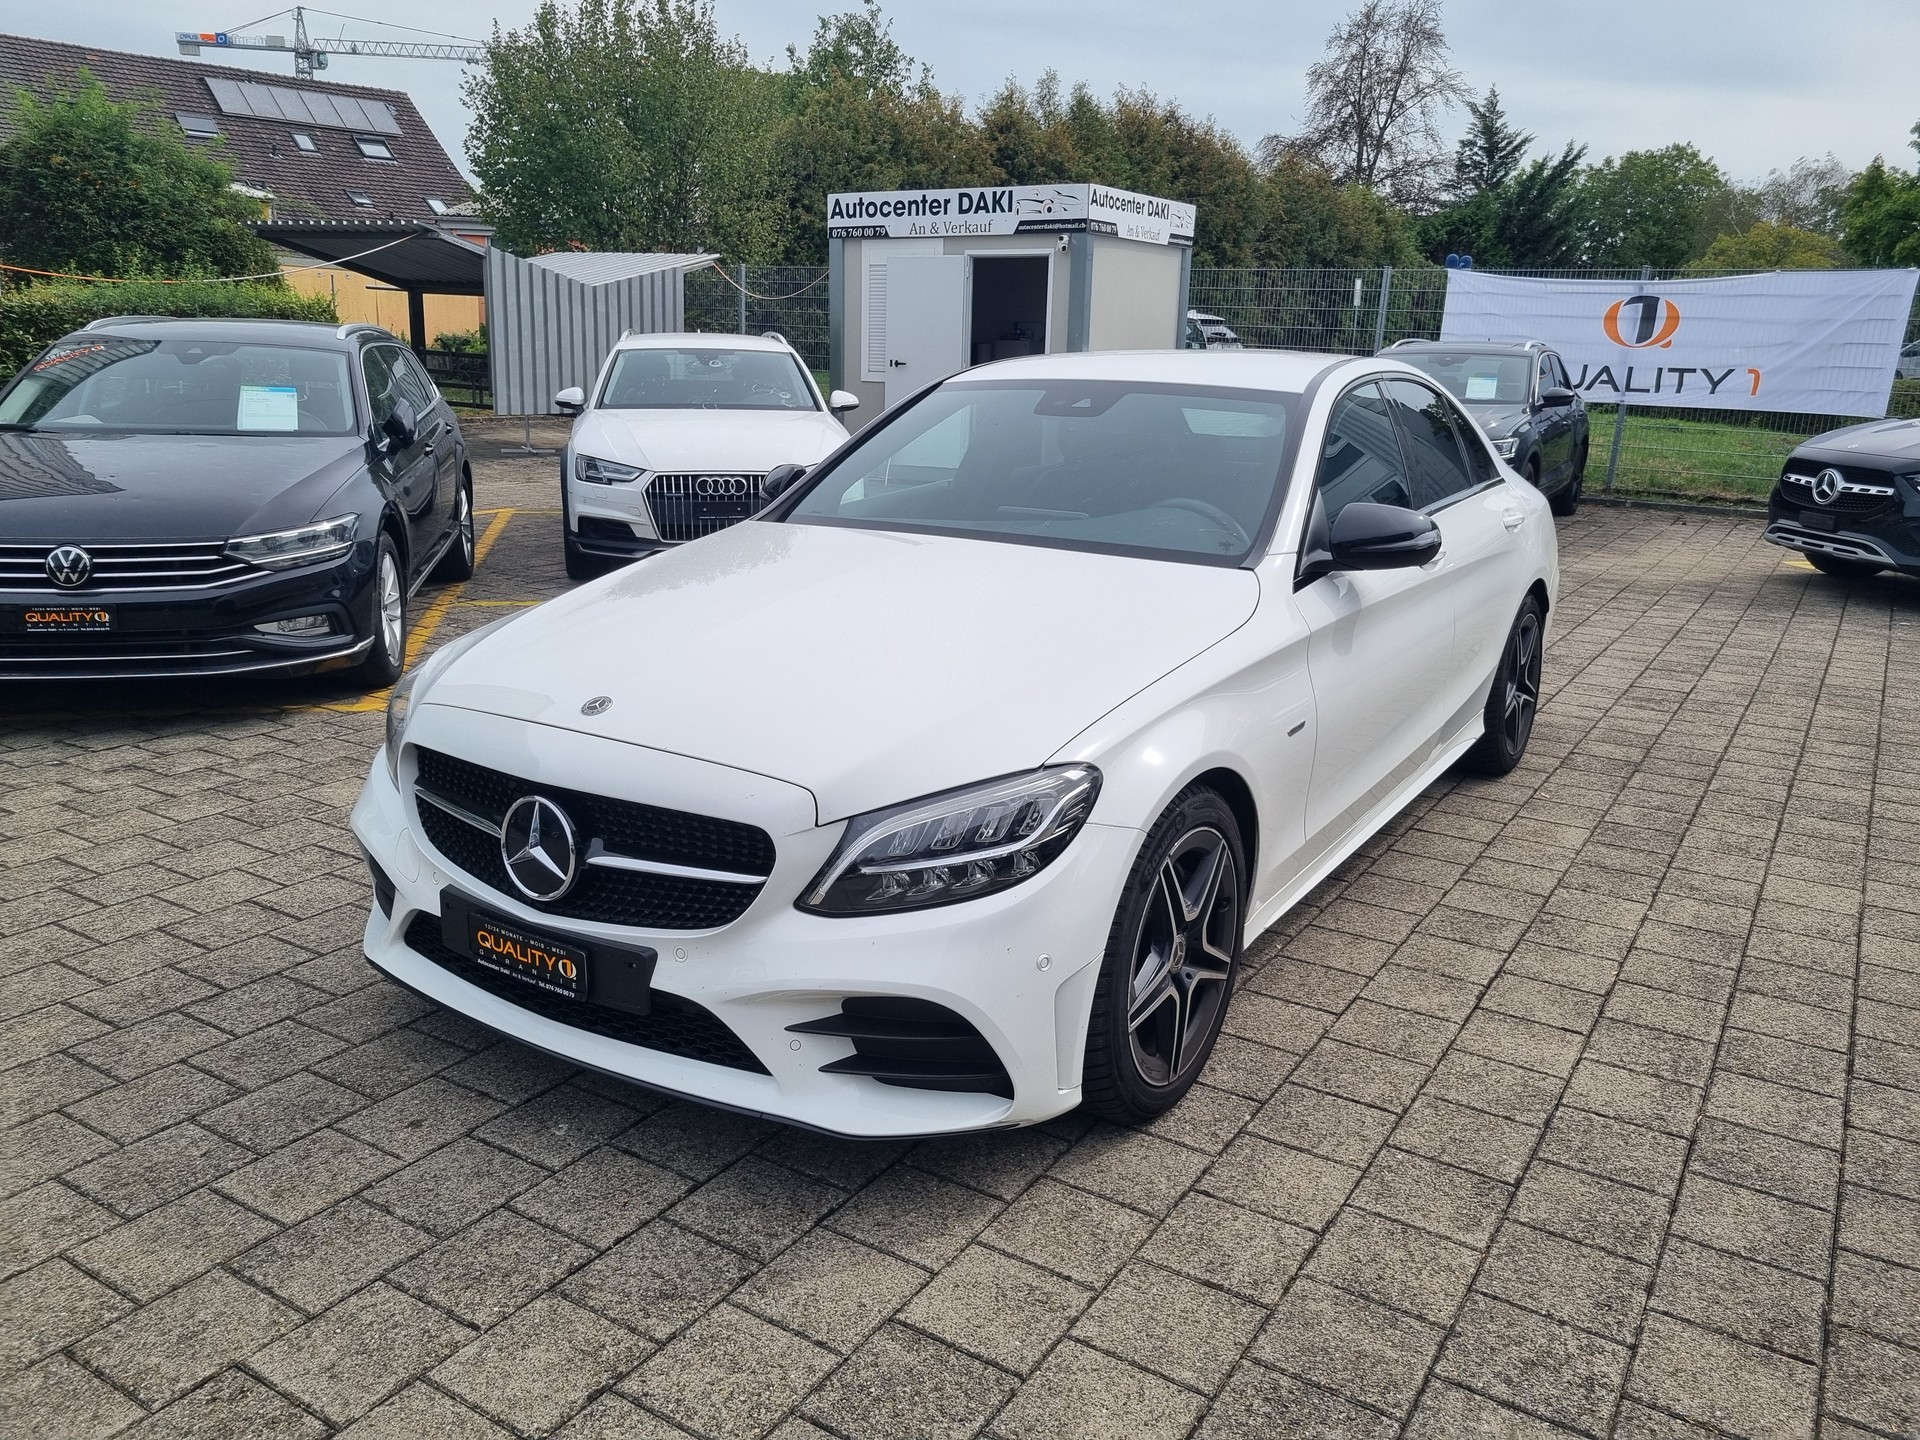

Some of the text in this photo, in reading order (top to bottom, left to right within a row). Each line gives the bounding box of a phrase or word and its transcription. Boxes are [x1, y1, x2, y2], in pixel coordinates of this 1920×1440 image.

[830, 190, 1014, 219] Autocenter DAKI
[1090, 188, 1170, 220] Autocenter DAKI
[832, 227, 886, 238] 076 760 00 79
[909, 219, 994, 235] An & Verkauf
[1126, 224, 1134, 237] An
[1140, 226, 1161, 241] Verkauf
[1568, 363, 1736, 395] UALITY
[25, 612, 93, 622] QUALITY
[477, 930, 557, 971] QUALITY
[501, 929, 523, 941] MONATE
[530, 939, 545, 949] MOIS
[551, 946, 566, 956] MESI
[479, 949, 577, 989] GARANTIE
